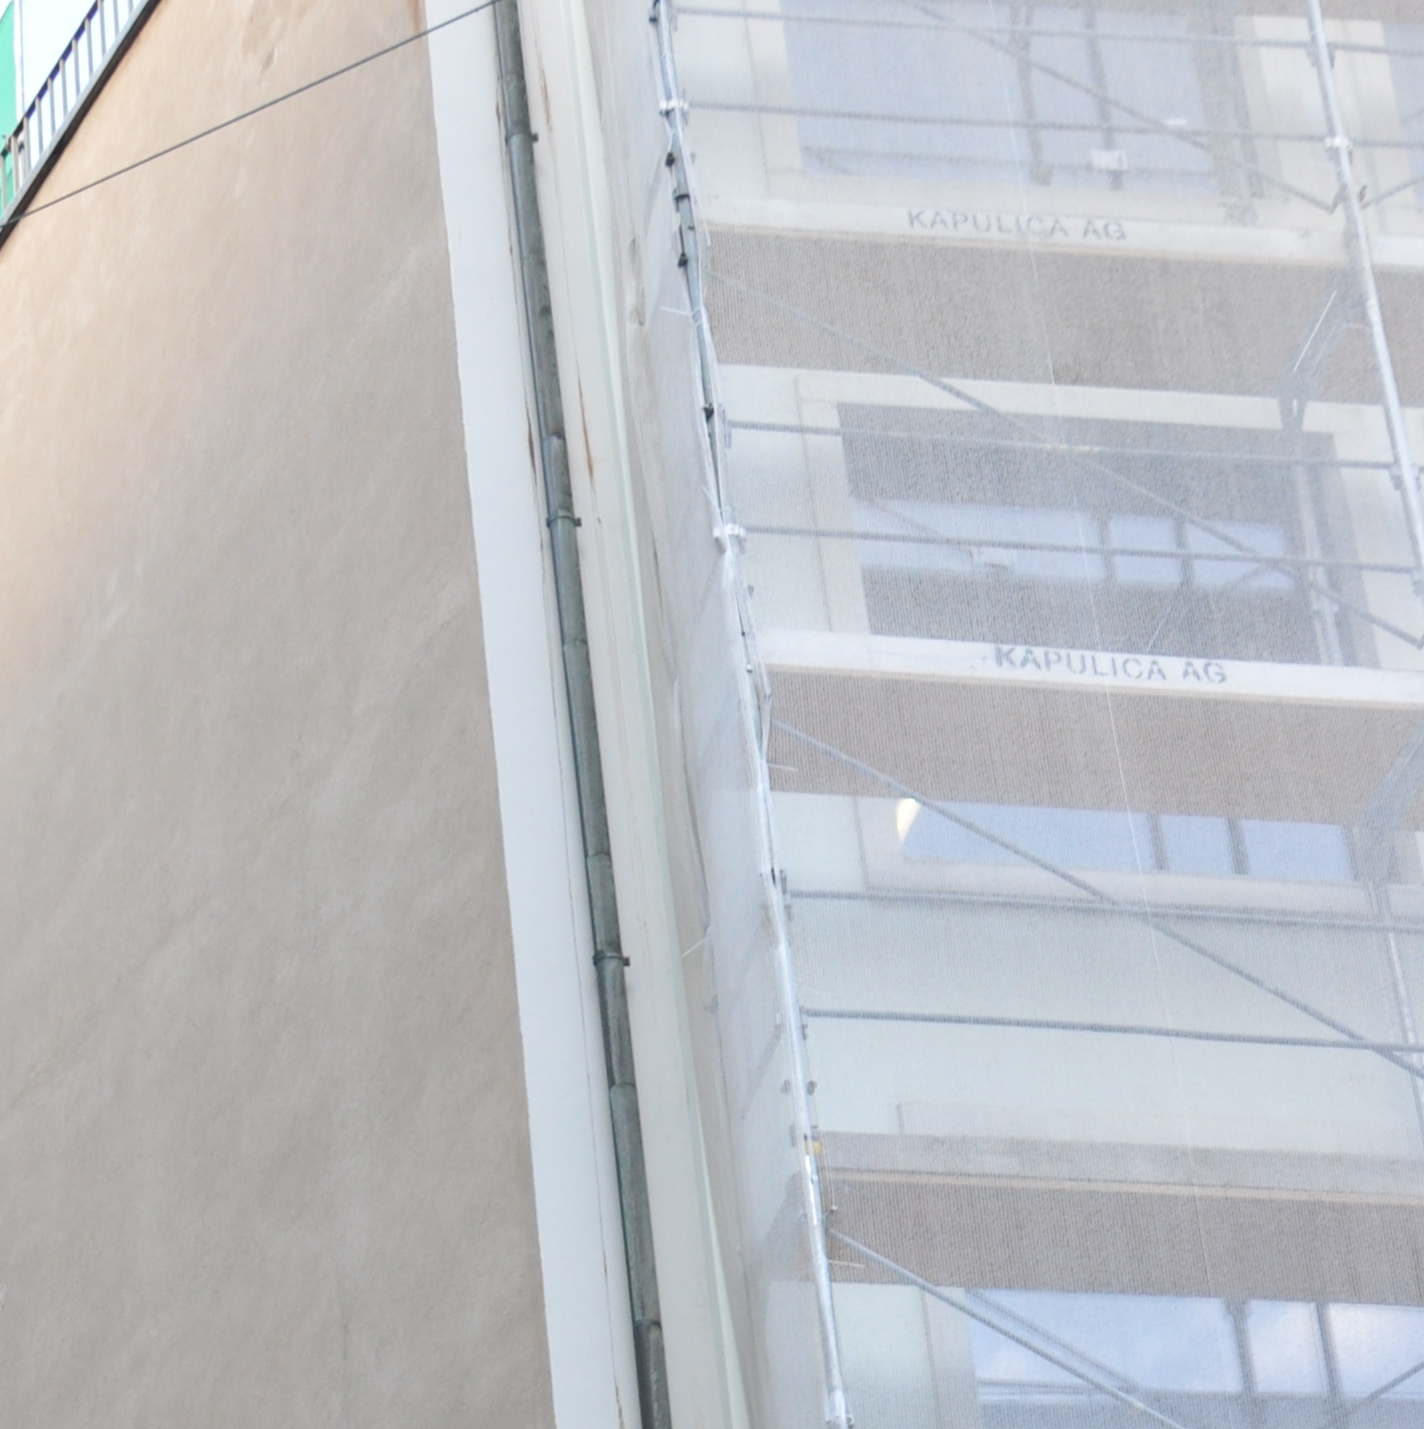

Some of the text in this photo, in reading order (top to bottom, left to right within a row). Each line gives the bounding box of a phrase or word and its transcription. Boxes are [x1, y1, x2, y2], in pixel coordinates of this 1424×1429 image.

[907, 208, 1126, 241] KAPULICA AG
[994, 645, 1227, 684] KAPULICA AG
